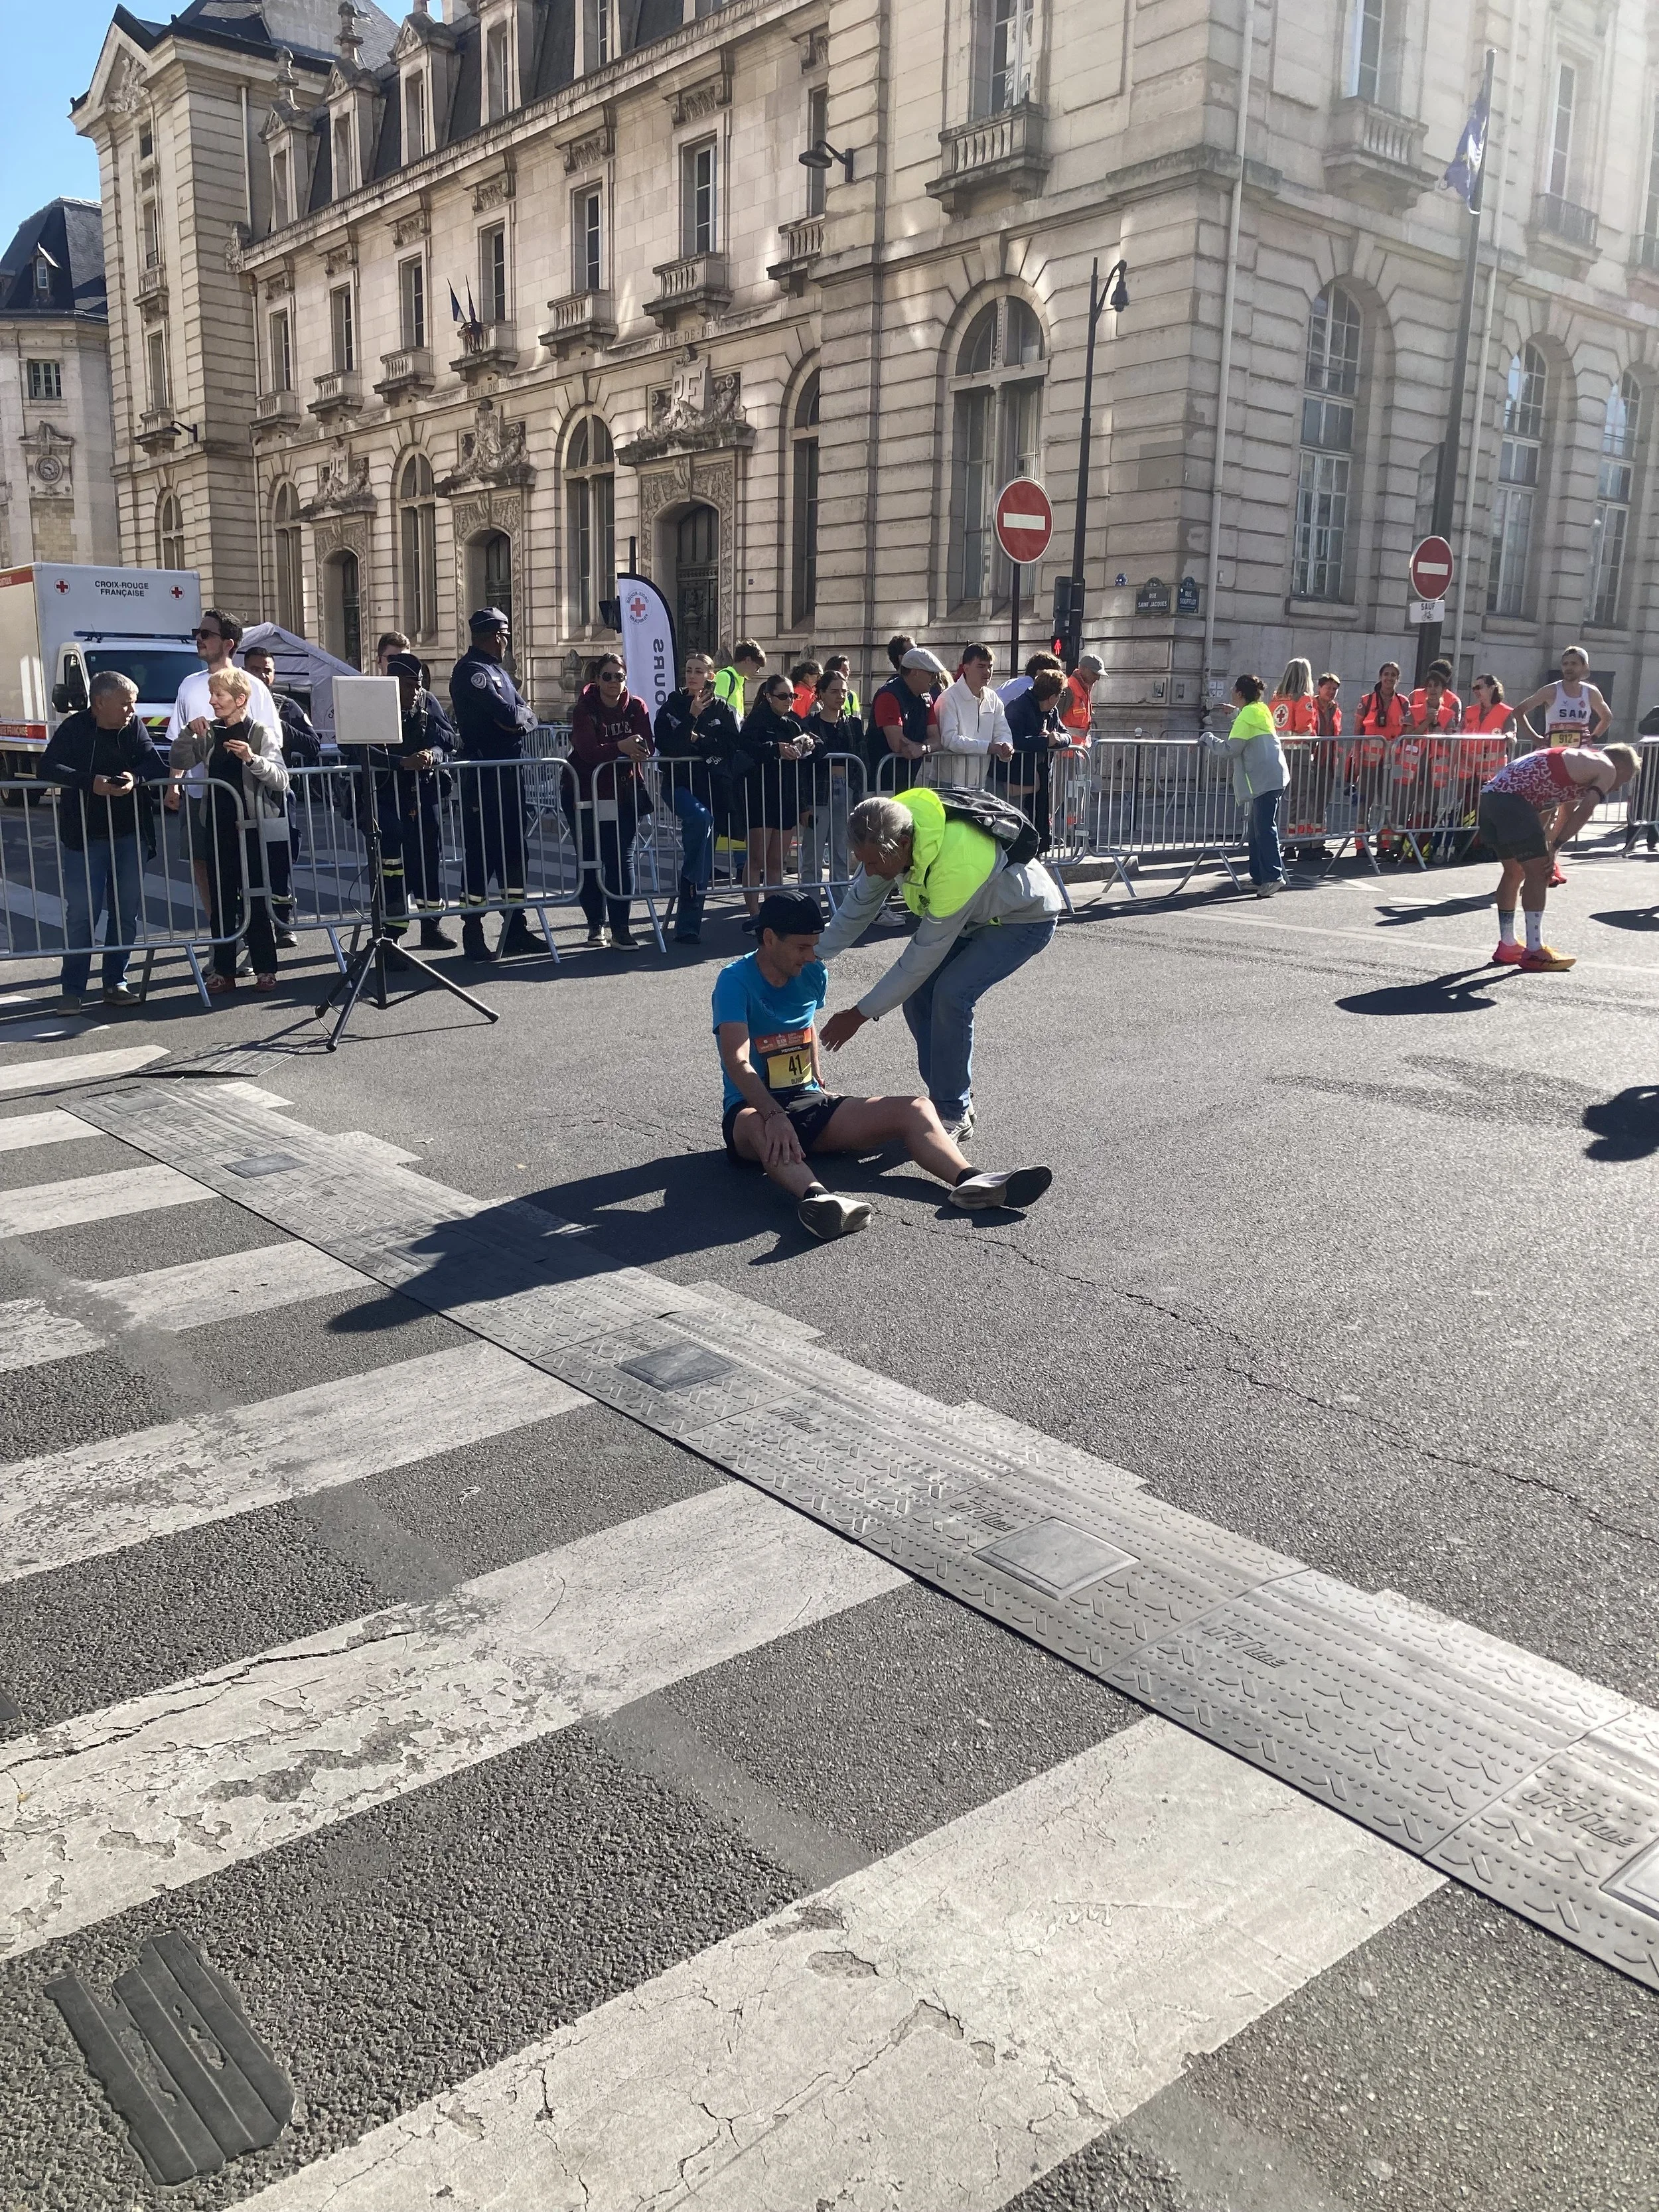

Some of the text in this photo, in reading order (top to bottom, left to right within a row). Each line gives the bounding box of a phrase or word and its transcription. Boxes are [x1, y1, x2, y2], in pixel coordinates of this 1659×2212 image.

[684, 329, 695, 341] DE
[95, 581, 149, 589] CROIX-ROUGE
[100, 589, 145, 598] FRANÇAISE
[1421, 602, 1435, 611] SAUF
[1559, 708, 1587, 719] SAM
[1559, 733, 1573, 744] 912
[788, 1054, 802, 1075] 41
